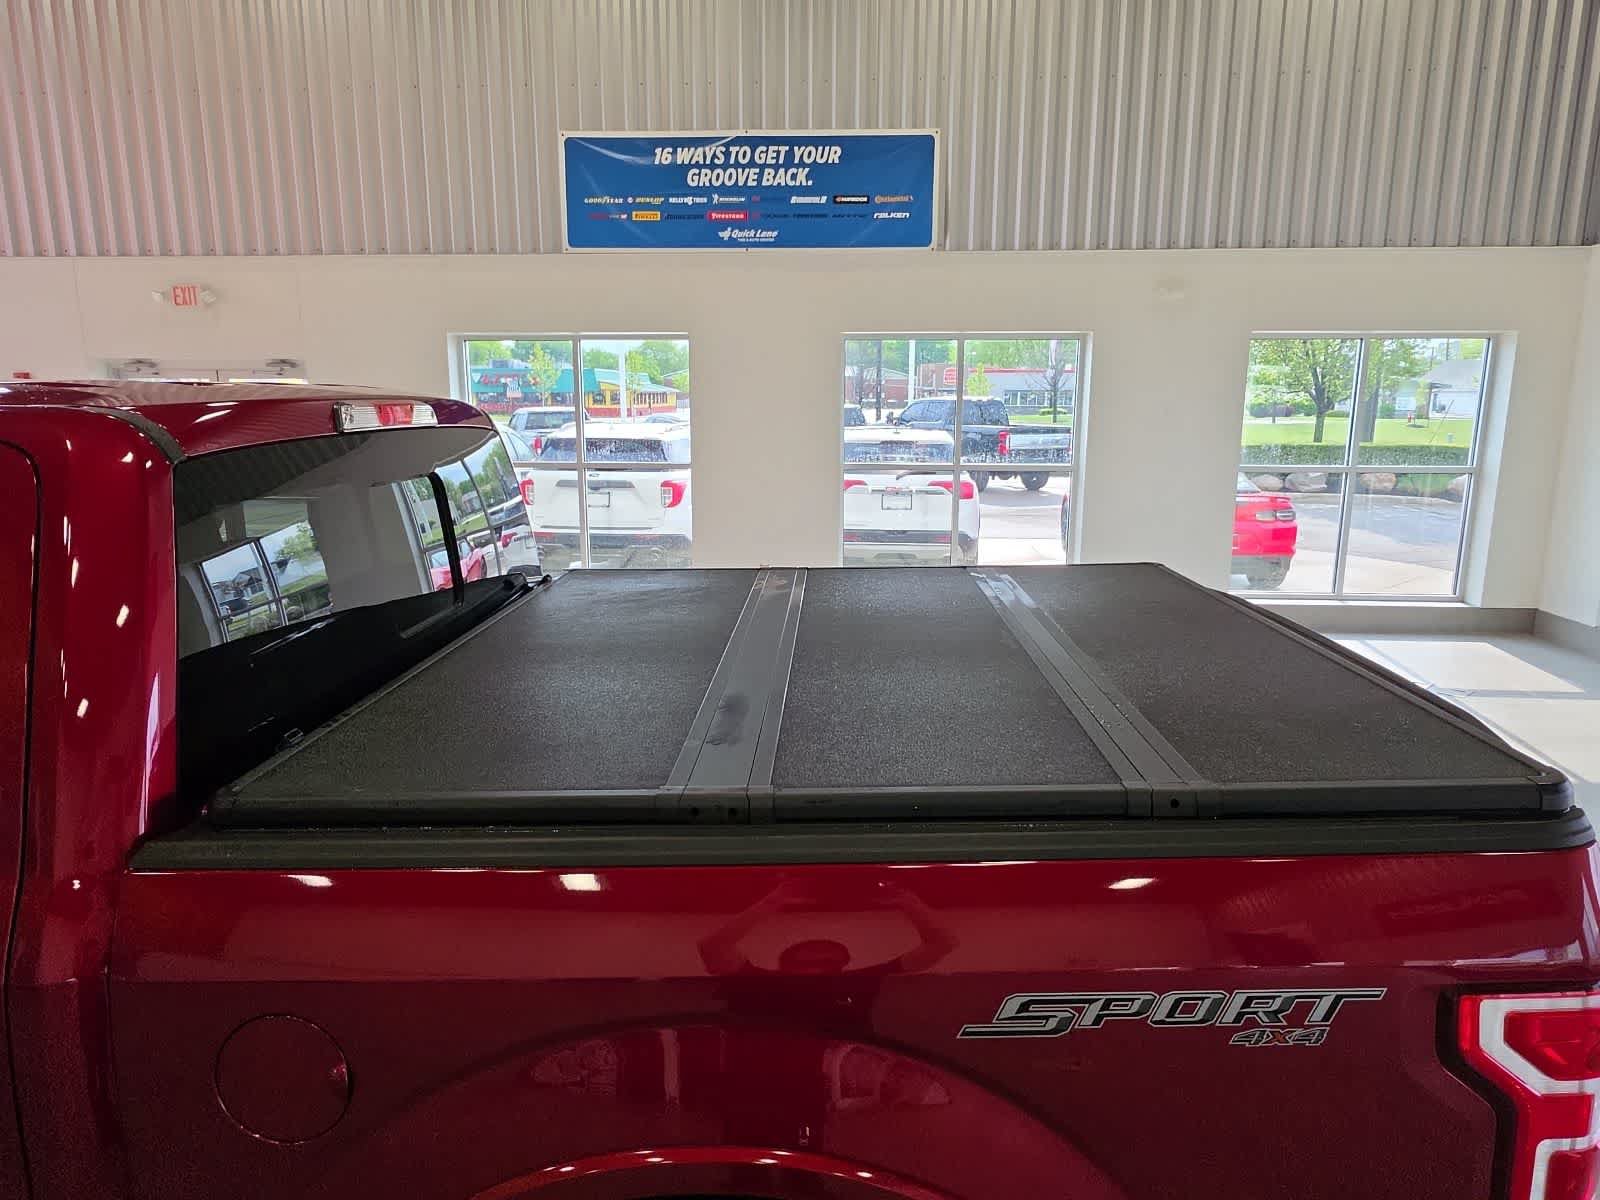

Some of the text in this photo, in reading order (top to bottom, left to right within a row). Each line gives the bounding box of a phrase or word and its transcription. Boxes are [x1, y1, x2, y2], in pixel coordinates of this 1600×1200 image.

[654, 145, 841, 165] 16 WAYS TO GET YOUR
[687, 167, 813, 187] GROOVE BACK.
[731, 229, 779, 239] Quick Lane
[172, 286, 198, 305] EXIT
[957, 987, 1387, 1039] SPORT
